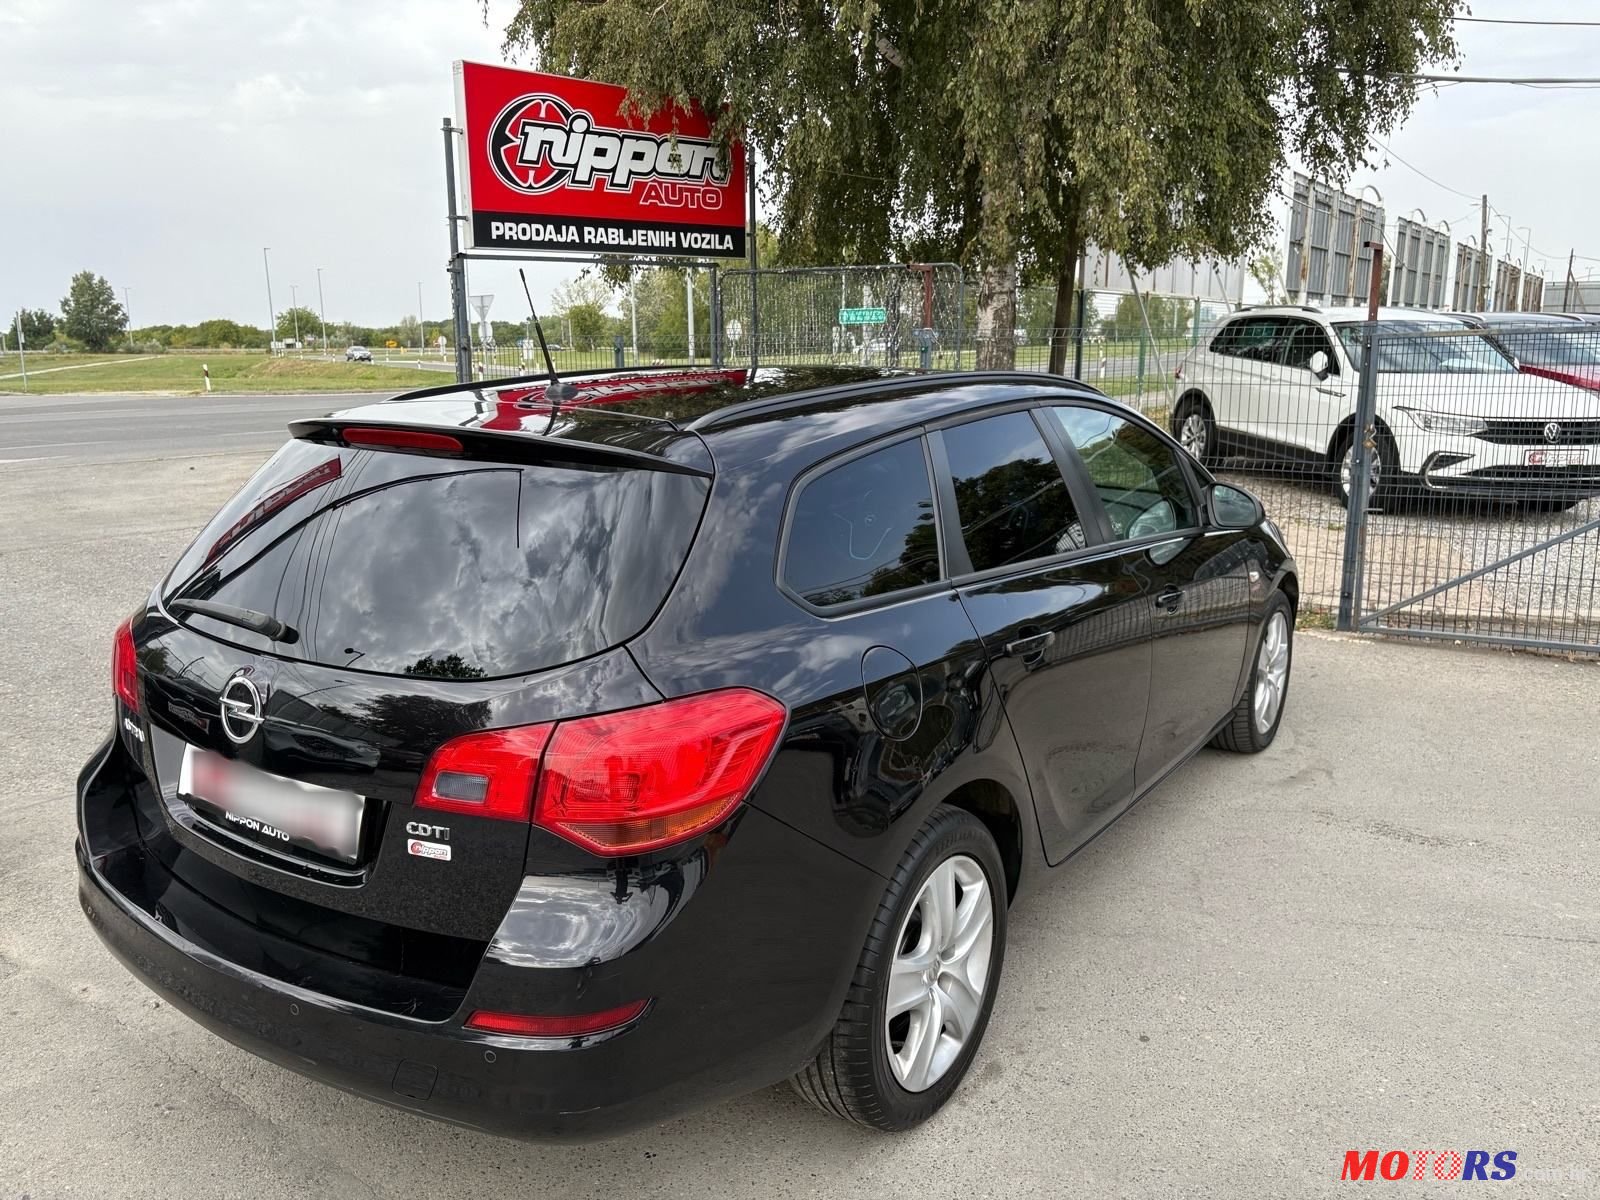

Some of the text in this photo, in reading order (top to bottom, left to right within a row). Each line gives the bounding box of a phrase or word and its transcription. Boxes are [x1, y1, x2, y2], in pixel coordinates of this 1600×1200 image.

[521, 116, 729, 186] nippon
[640, 182, 722, 210] AUTO
[491, 222, 734, 250] PRODAJA RABLJENIH VOZILA
[225, 810, 290, 842] NIPPON AUTO
